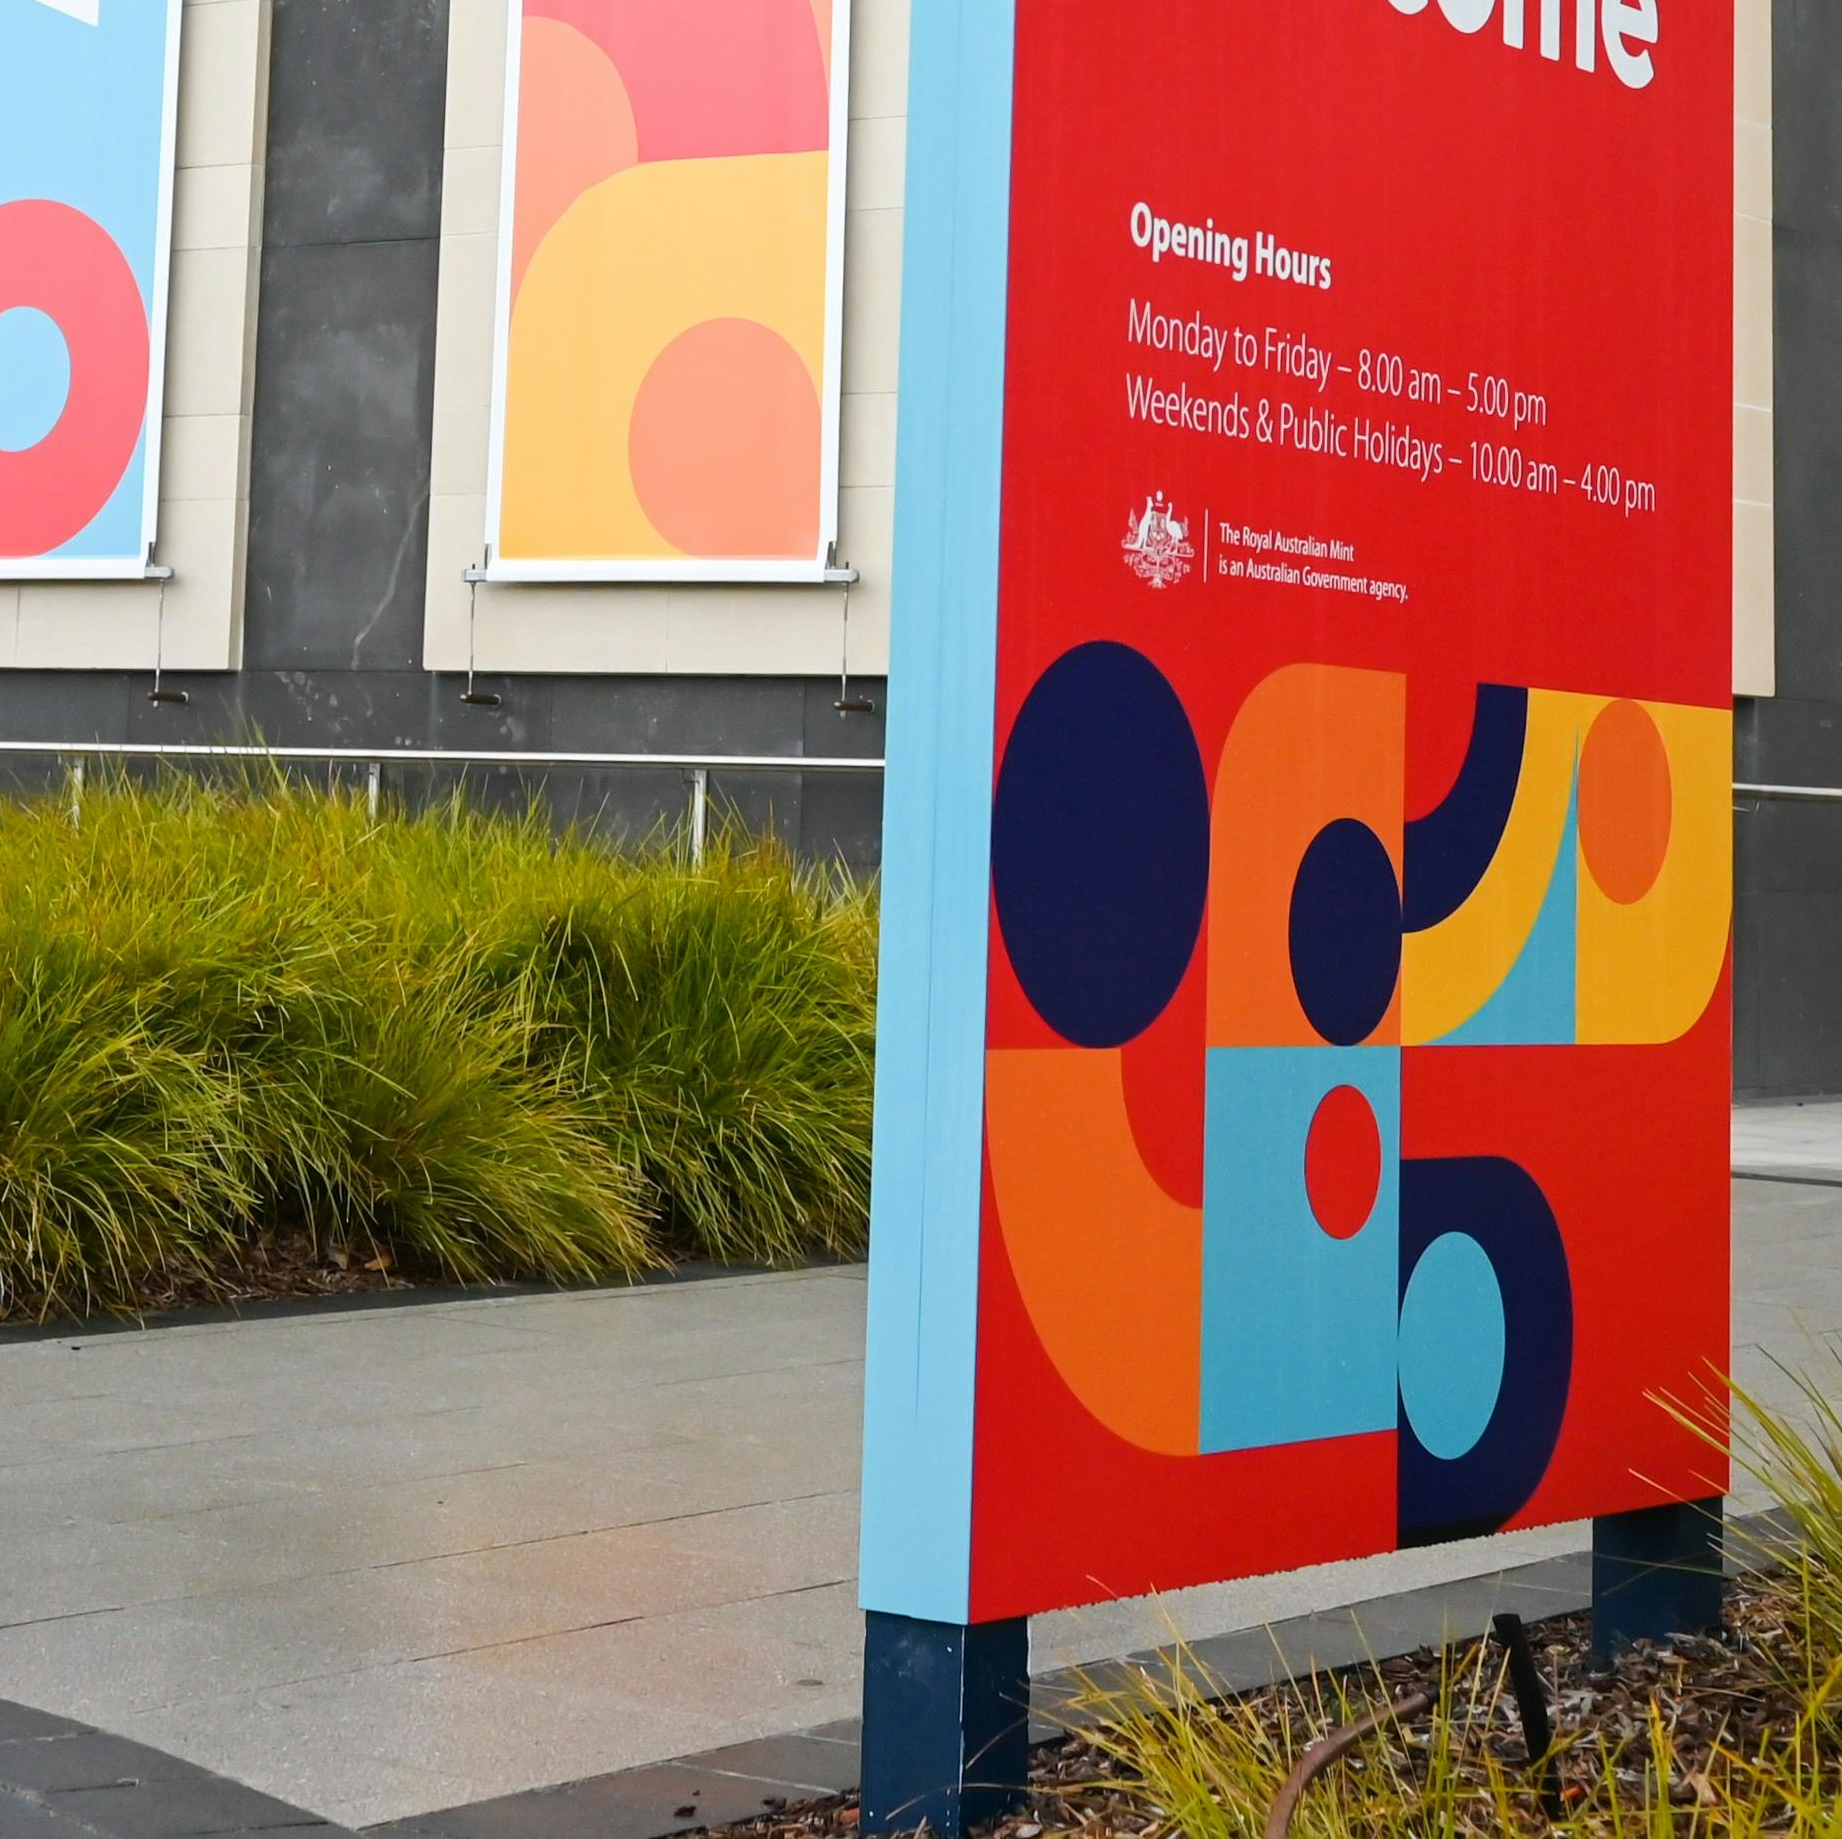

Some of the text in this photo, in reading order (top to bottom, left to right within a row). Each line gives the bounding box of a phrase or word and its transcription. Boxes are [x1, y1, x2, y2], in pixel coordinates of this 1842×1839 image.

[1130, 200, 1333, 291] Opening Hours
[1127, 297, 1229, 372] Monday
[1233, 325, 1259, 368] to
[1263, 325, 1333, 394] Friday
[1356, 347, 1404, 398] 8.00
[1406, 368, 1442, 405] am
[1465, 371, 1510, 419] 5.00
[1513, 390, 1548, 432] pm
[1124, 371, 1251, 440] Weekends
[1254, 397, 1275, 445] &
[1279, 401, 1349, 458] Public
[1352, 416, 1444, 484] Holidays
[1469, 440, 1523, 489] 10.00
[1525, 459, 1558, 495] am
[1579, 462, 1622, 507] 4.00
[1624, 478, 1656, 519] pm
[1218, 554, 1409, 605] is an Australian Government agency.
[1219, 522, 1356, 563] The Royal Australian Mint
